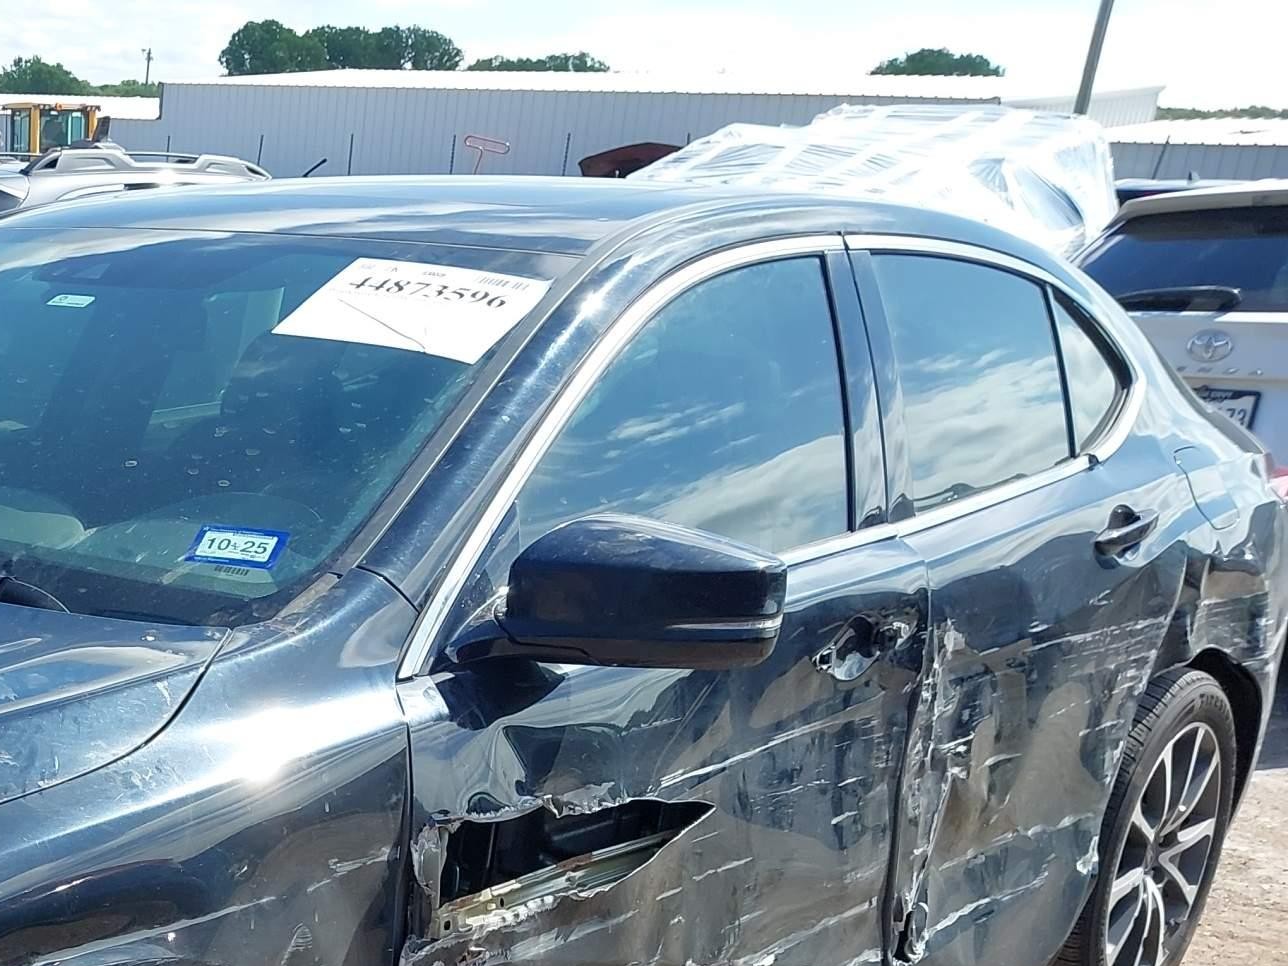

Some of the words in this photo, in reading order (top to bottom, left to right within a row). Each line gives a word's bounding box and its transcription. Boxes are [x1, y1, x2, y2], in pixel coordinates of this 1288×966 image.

[349, 276, 506, 308] 44873596
[207, 537, 232, 551] 10
[239, 540, 270, 555] 25
